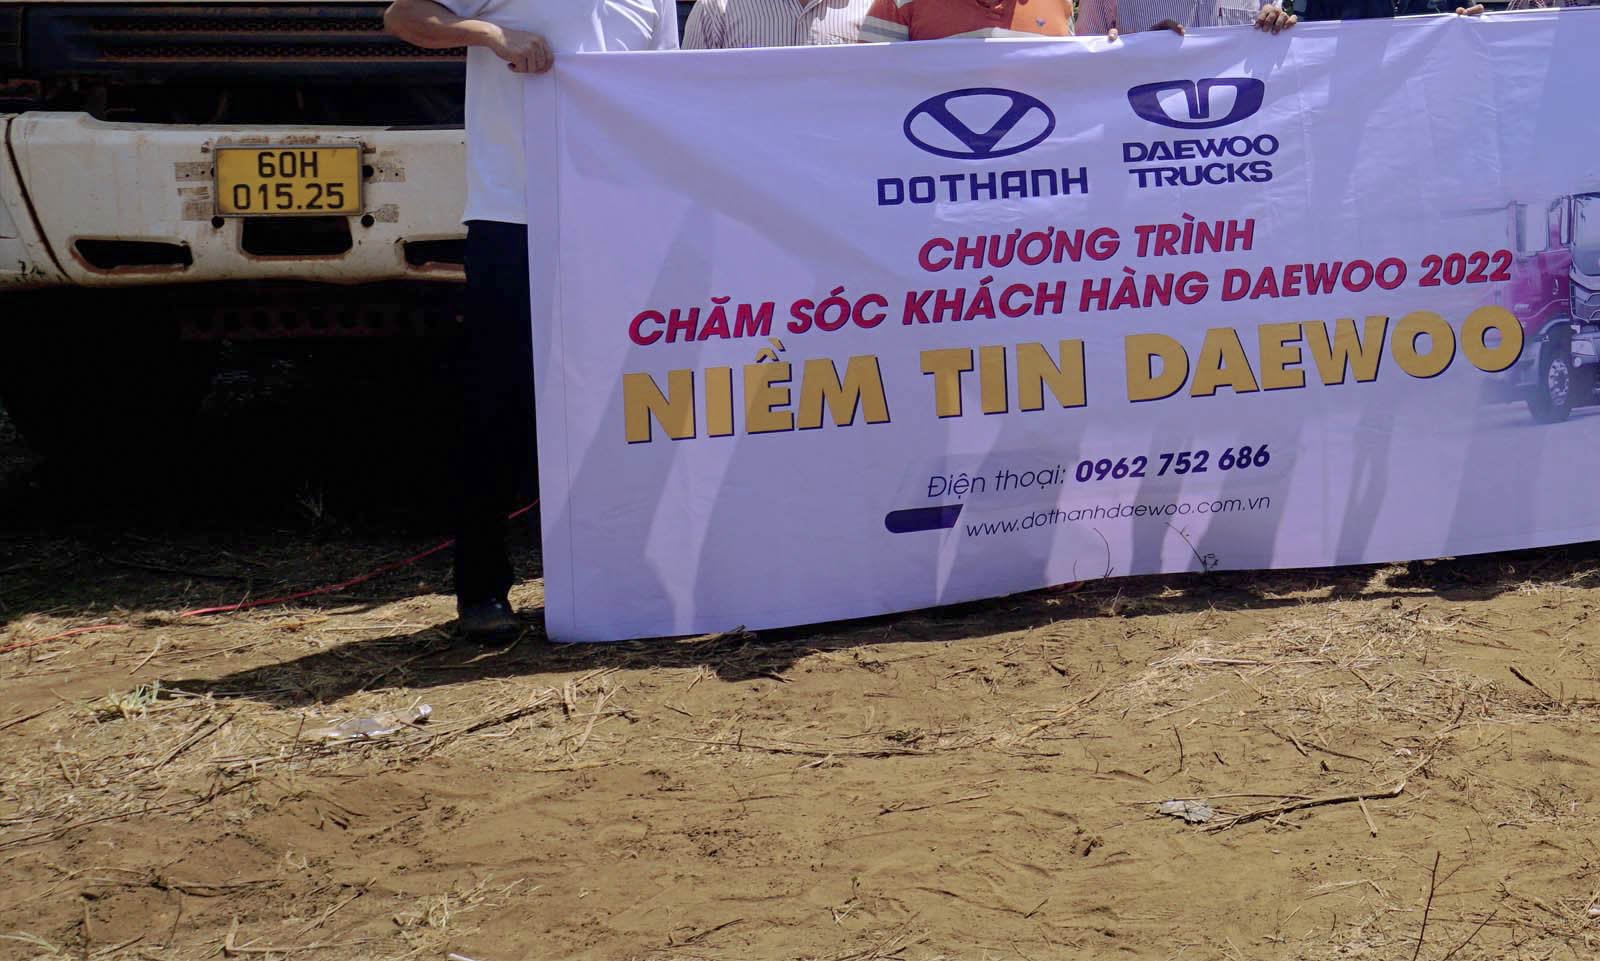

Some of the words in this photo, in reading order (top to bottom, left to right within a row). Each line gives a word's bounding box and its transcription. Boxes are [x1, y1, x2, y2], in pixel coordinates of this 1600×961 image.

[257, 151, 318, 178] 60H
[1122, 133, 1280, 163] DAEWOO
[877, 166, 1089, 206] DOTHANH
[1128, 160, 1273, 189] TRUCKS
[233, 182, 344, 210] 015.25
[918, 226, 1120, 272] CHƯƠNG
[1134, 212, 1256, 257] TRÌNH
[628, 295, 775, 346] CHĂM
[786, 285, 889, 335] SÓC
[902, 276, 1067, 325] KHÁCH
[1079, 267, 1209, 312] HÀNG
[1221, 257, 1407, 301] DAEWOO
[1418, 249, 1514, 288] 2022
[622, 338, 892, 444] NIỀM
[919, 339, 1088, 418] TIN
[1124, 306, 1526, 404] DAEWOO
[928, 472, 986, 500] Điện
[996, 465, 1066, 492] thoại:
[1075, 455, 1149, 483] 0962
[1157, 449, 1211, 476] 752
[1218, 443, 1272, 471] 686
[966, 495, 1271, 537] www.dothanhdaewoo.com.vn
